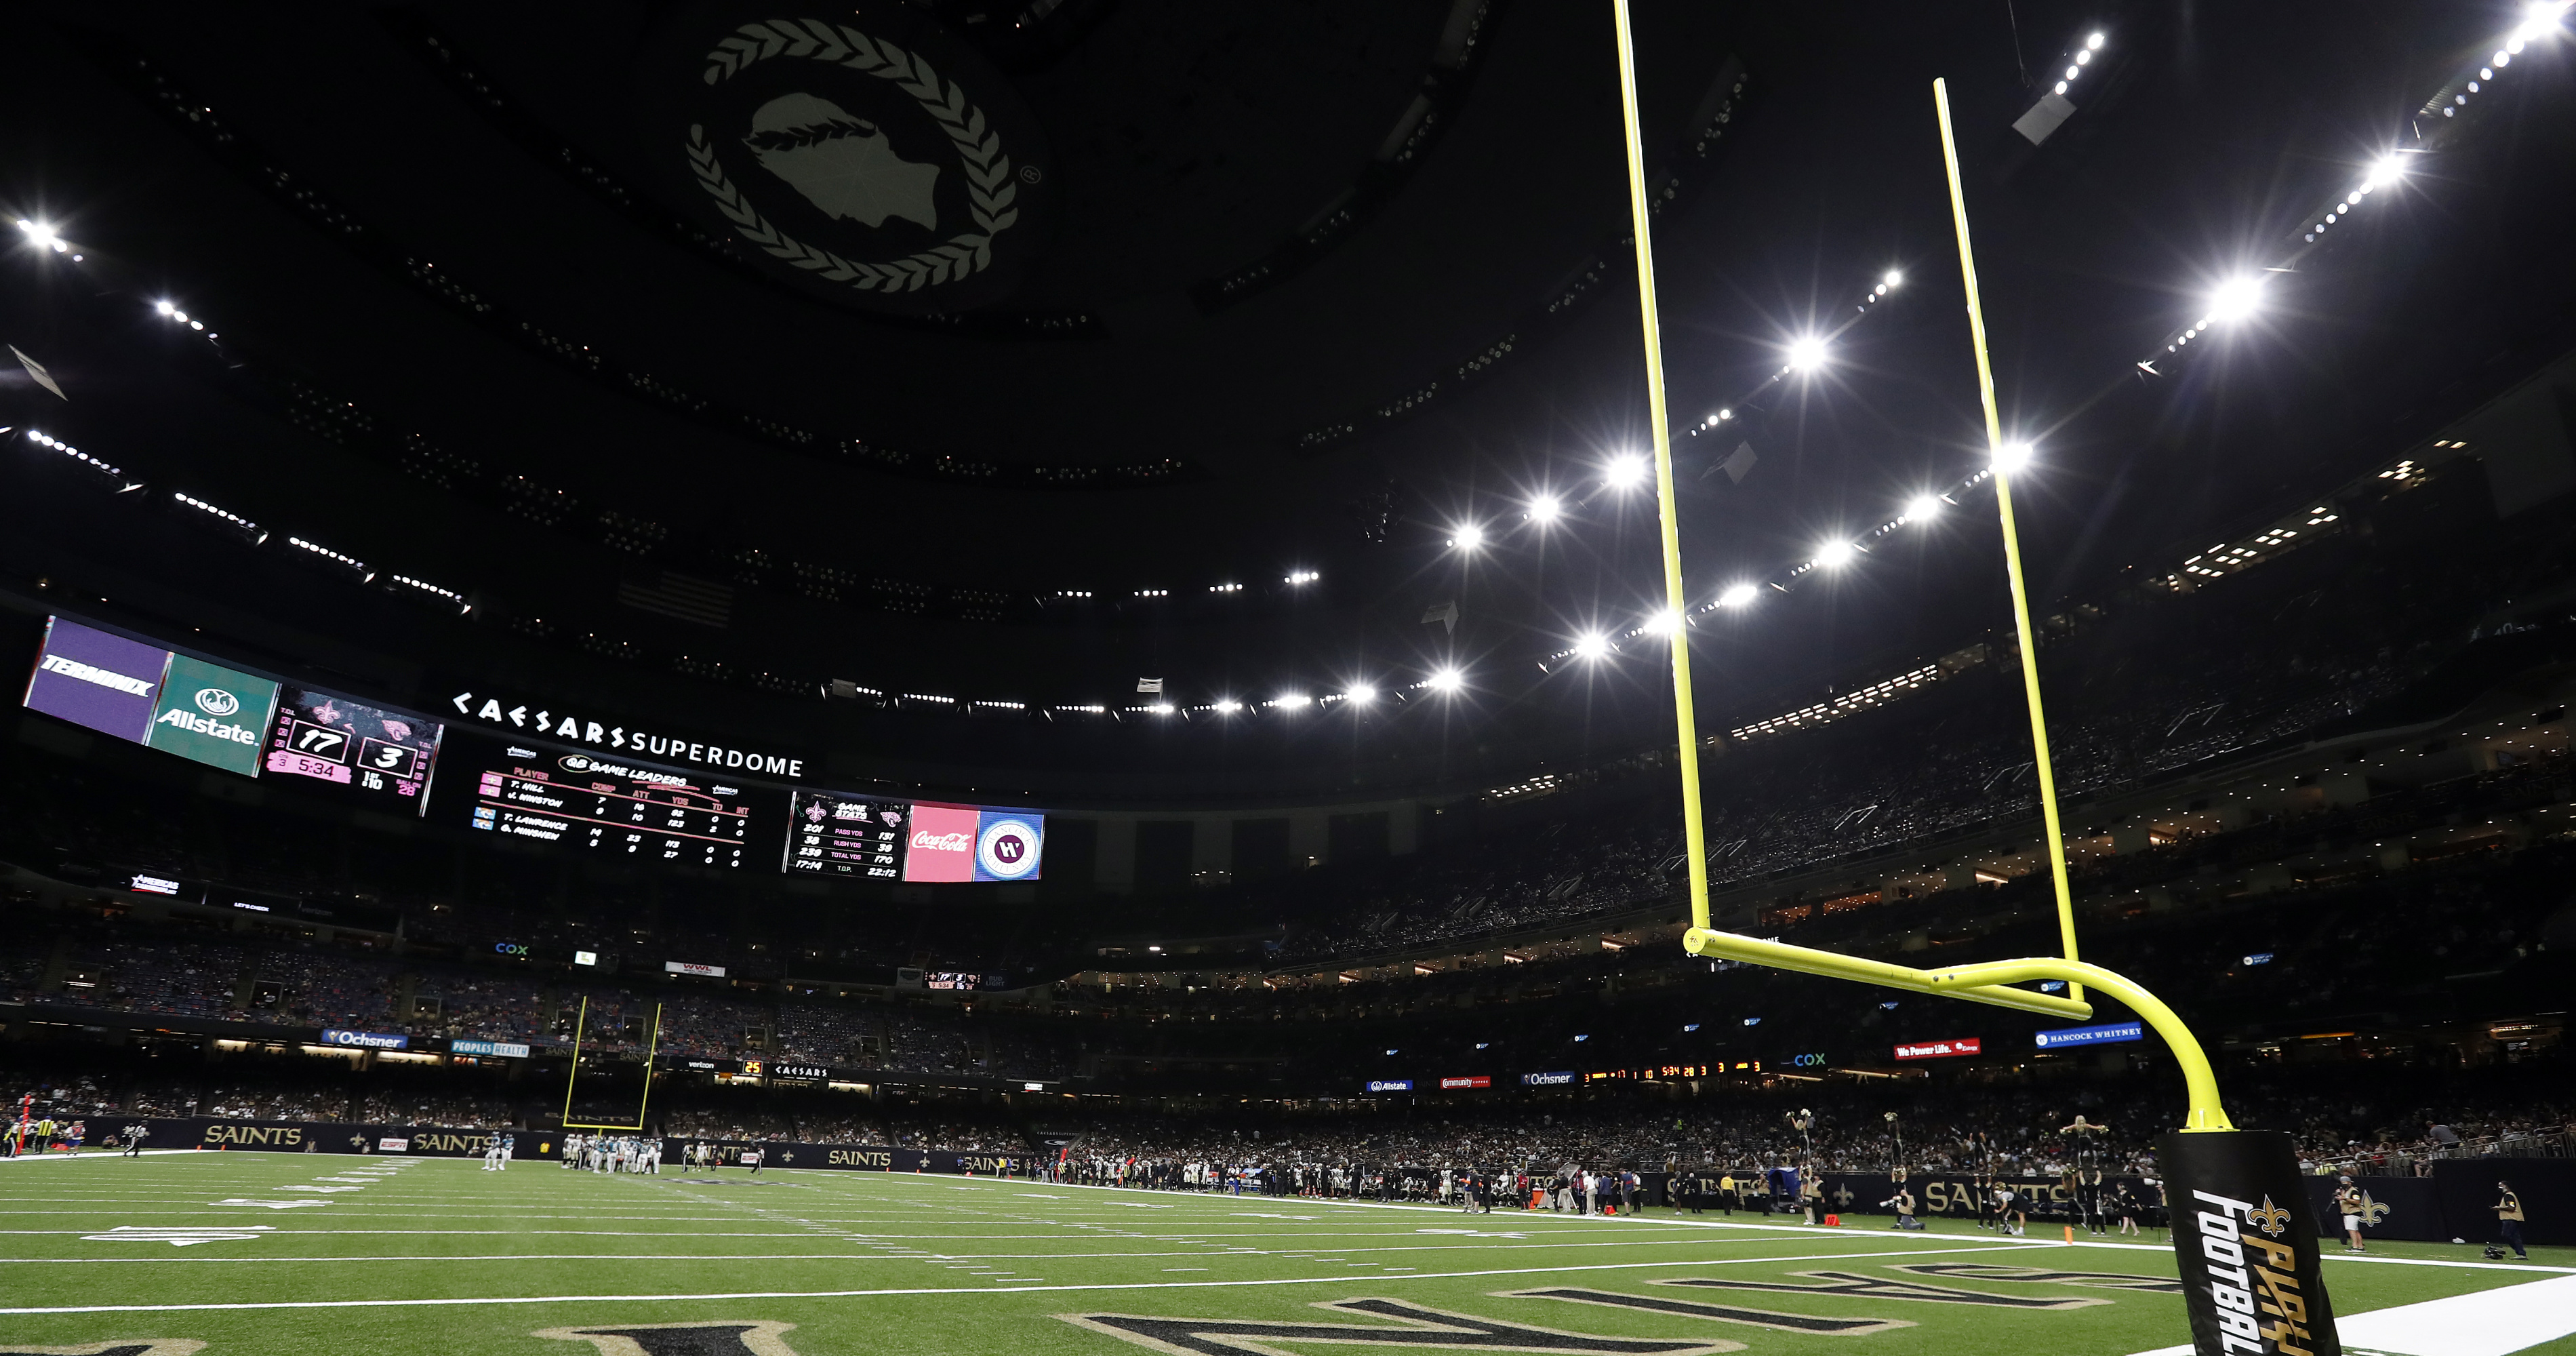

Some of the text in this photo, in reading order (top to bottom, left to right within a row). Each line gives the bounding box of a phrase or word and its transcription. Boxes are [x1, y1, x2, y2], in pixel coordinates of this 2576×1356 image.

[39, 654, 155, 698] TERMINIX
[452, 692, 803, 778] CAESARS SUPERDOME
[298, 729, 343, 753] 17
[279, 758, 286, 767] 3
[375, 747, 403, 768] 3
[298, 759, 334, 778] 5:34
[514, 767, 549, 781] PLAYER
[566, 757, 687, 787] QB GAME LEADERS
[397, 784, 416, 797] 28
[522, 783, 544, 793] HILL
[591, 782, 616, 793] COMP
[2095, 778, 2145, 800] SAINTS
[632, 790, 650, 799] ATT
[519, 794, 563, 808] WINSTON
[672, 797, 689, 805] YDS
[595, 807, 605, 815] 9
[712, 803, 723, 811] TD
[736, 807, 750, 815] INT
[838, 803, 867, 812] GAME
[834, 810, 868, 819] STATS
[1989, 811, 2032, 826] SAINTS
[515, 816, 568, 831] LAWRENCE
[667, 819, 685, 828] 123
[2356, 810, 2417, 833] SAINTS
[513, 826, 560, 841] MINSHEW
[590, 828, 602, 837] 14
[803, 824, 824, 833] 201
[626, 835, 641, 843] 23
[804, 836, 820, 845] 38
[879, 832, 895, 841] 131
[987, 826, 1032, 845] HANCOCK
[665, 840, 681, 848] 113
[911, 831, 972, 852] Coca-Cola
[799, 848, 822, 857] 239
[877, 843, 893, 852] 39
[874, 855, 893, 864] 170
[986, 852, 1032, 873] WHITNEY
[1813, 857, 1847, 871] SAINTS
[795, 860, 823, 871] 17:14
[867, 867, 897, 877] 22:12
[136, 874, 179, 890] AMERICAS
[1737, 876, 1770, 888] SAINTS
[1605, 905, 1632, 916] SAINTS
[1546, 918, 1571, 927] SAINTS
[1437, 937, 1460, 945] SAINTS
[496, 943, 528, 955] COX
[339, 1032, 401, 1048] Ochsner
[2051, 1027, 2141, 1042] HANCOCK WHITNEY
[452, 1041, 529, 1056] PEOPLES HEALTH
[1897, 1043, 1952, 1057] We Power Life.
[1795, 1053, 1826, 1066] COX
[745, 1062, 761, 1073] 25
[776, 1066, 827, 1077] CAESARS
[1662, 1066, 1679, 1076] 5:34
[1684, 1067, 1694, 1077] 28
[1701, 1066, 1706, 1075] 3
[1718, 1062, 1725, 1073] 3
[1754, 1062, 1760, 1071] 3
[1531, 1073, 1570, 1085] Ochsner
[1585, 1074, 1590, 1082] 3
[1617, 1070, 1626, 1078] 17
[1634, 1071, 1637, 1079] 1
[1645, 1070, 1653, 1079] 10
[1443, 1078, 1472, 1088] Community
[205, 1125, 302, 1145] SAINTS
[381, 1140, 406, 1149] ESPN
[828, 1151, 891, 1167] SAINTS
[1828, 1217, 1835, 1225] 10
[2192, 1189, 2263, 1356] FOOTBAL
[2240, 1234, 2314, 1356] PLAY
